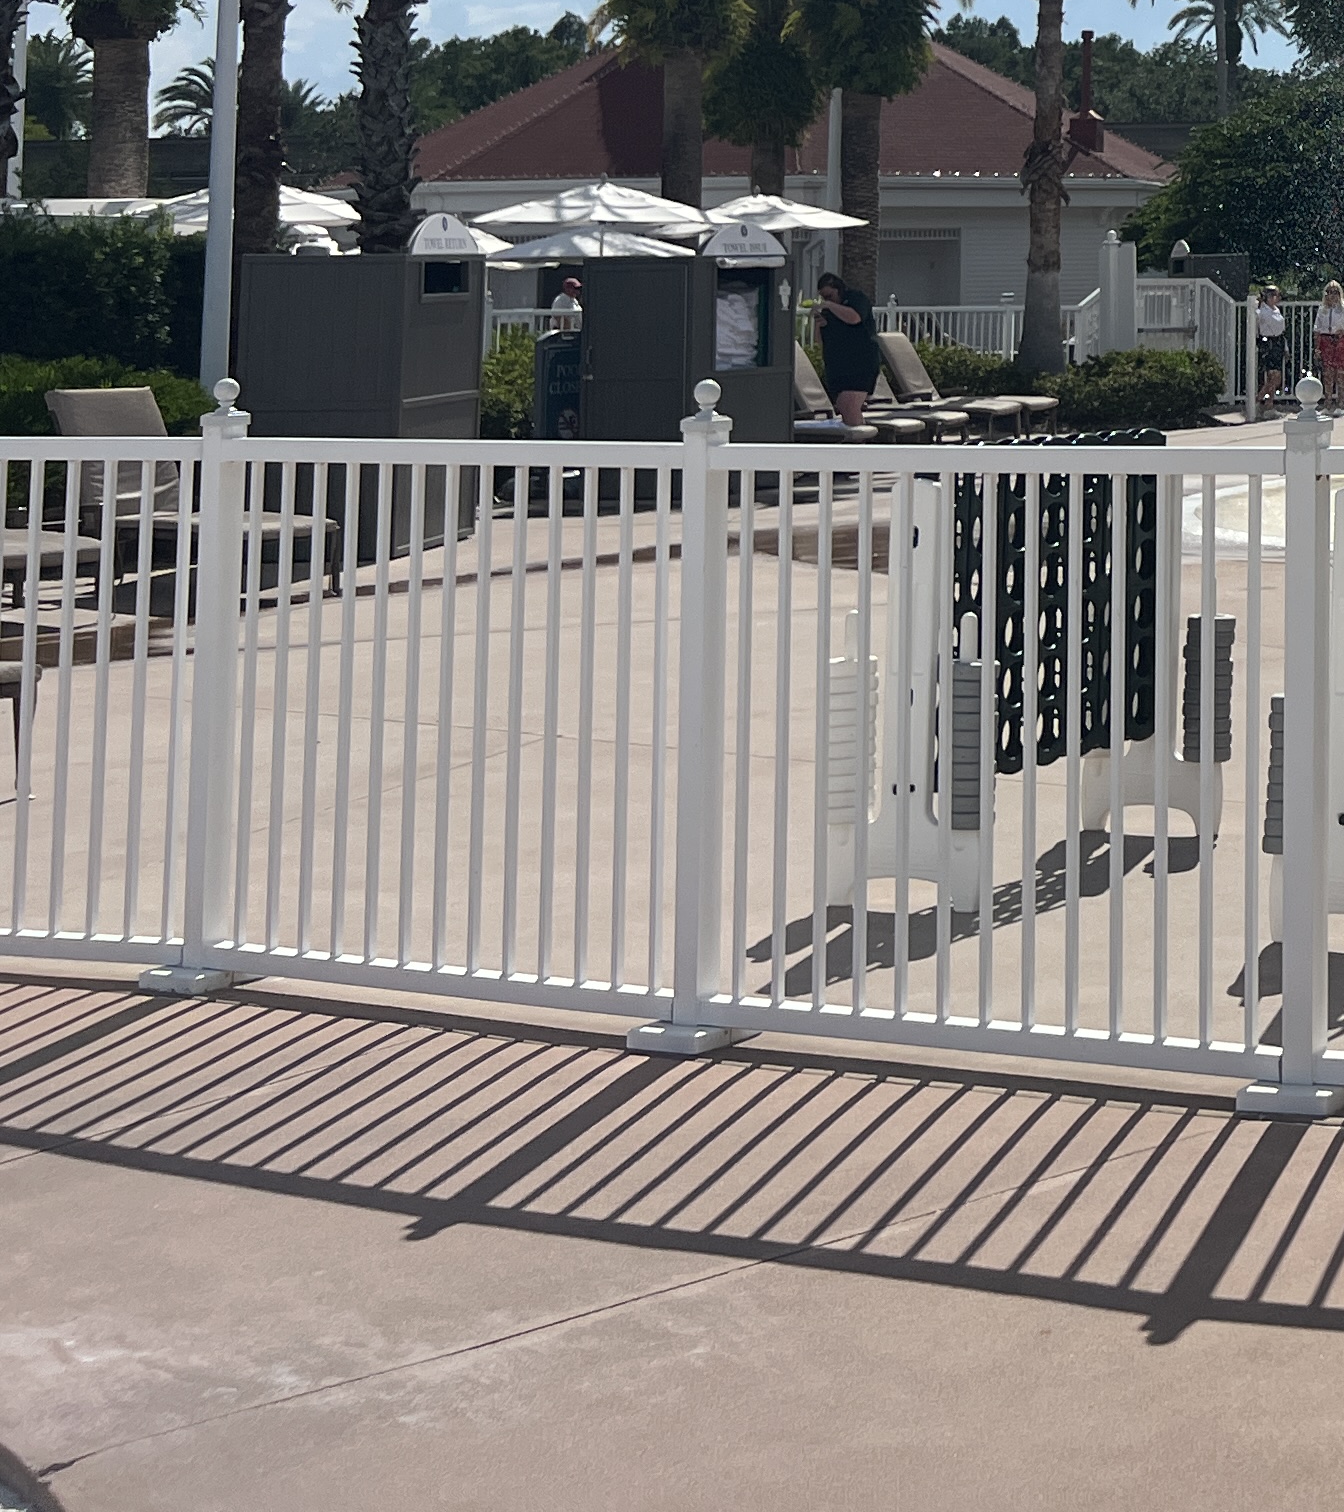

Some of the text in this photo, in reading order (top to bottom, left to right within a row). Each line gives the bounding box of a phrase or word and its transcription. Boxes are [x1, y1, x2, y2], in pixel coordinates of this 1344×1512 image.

[424, 238, 467, 249] TOWEL RETURN
[723, 243, 768, 253] TOWEL ISSUE
[557, 364, 580, 378] POO
